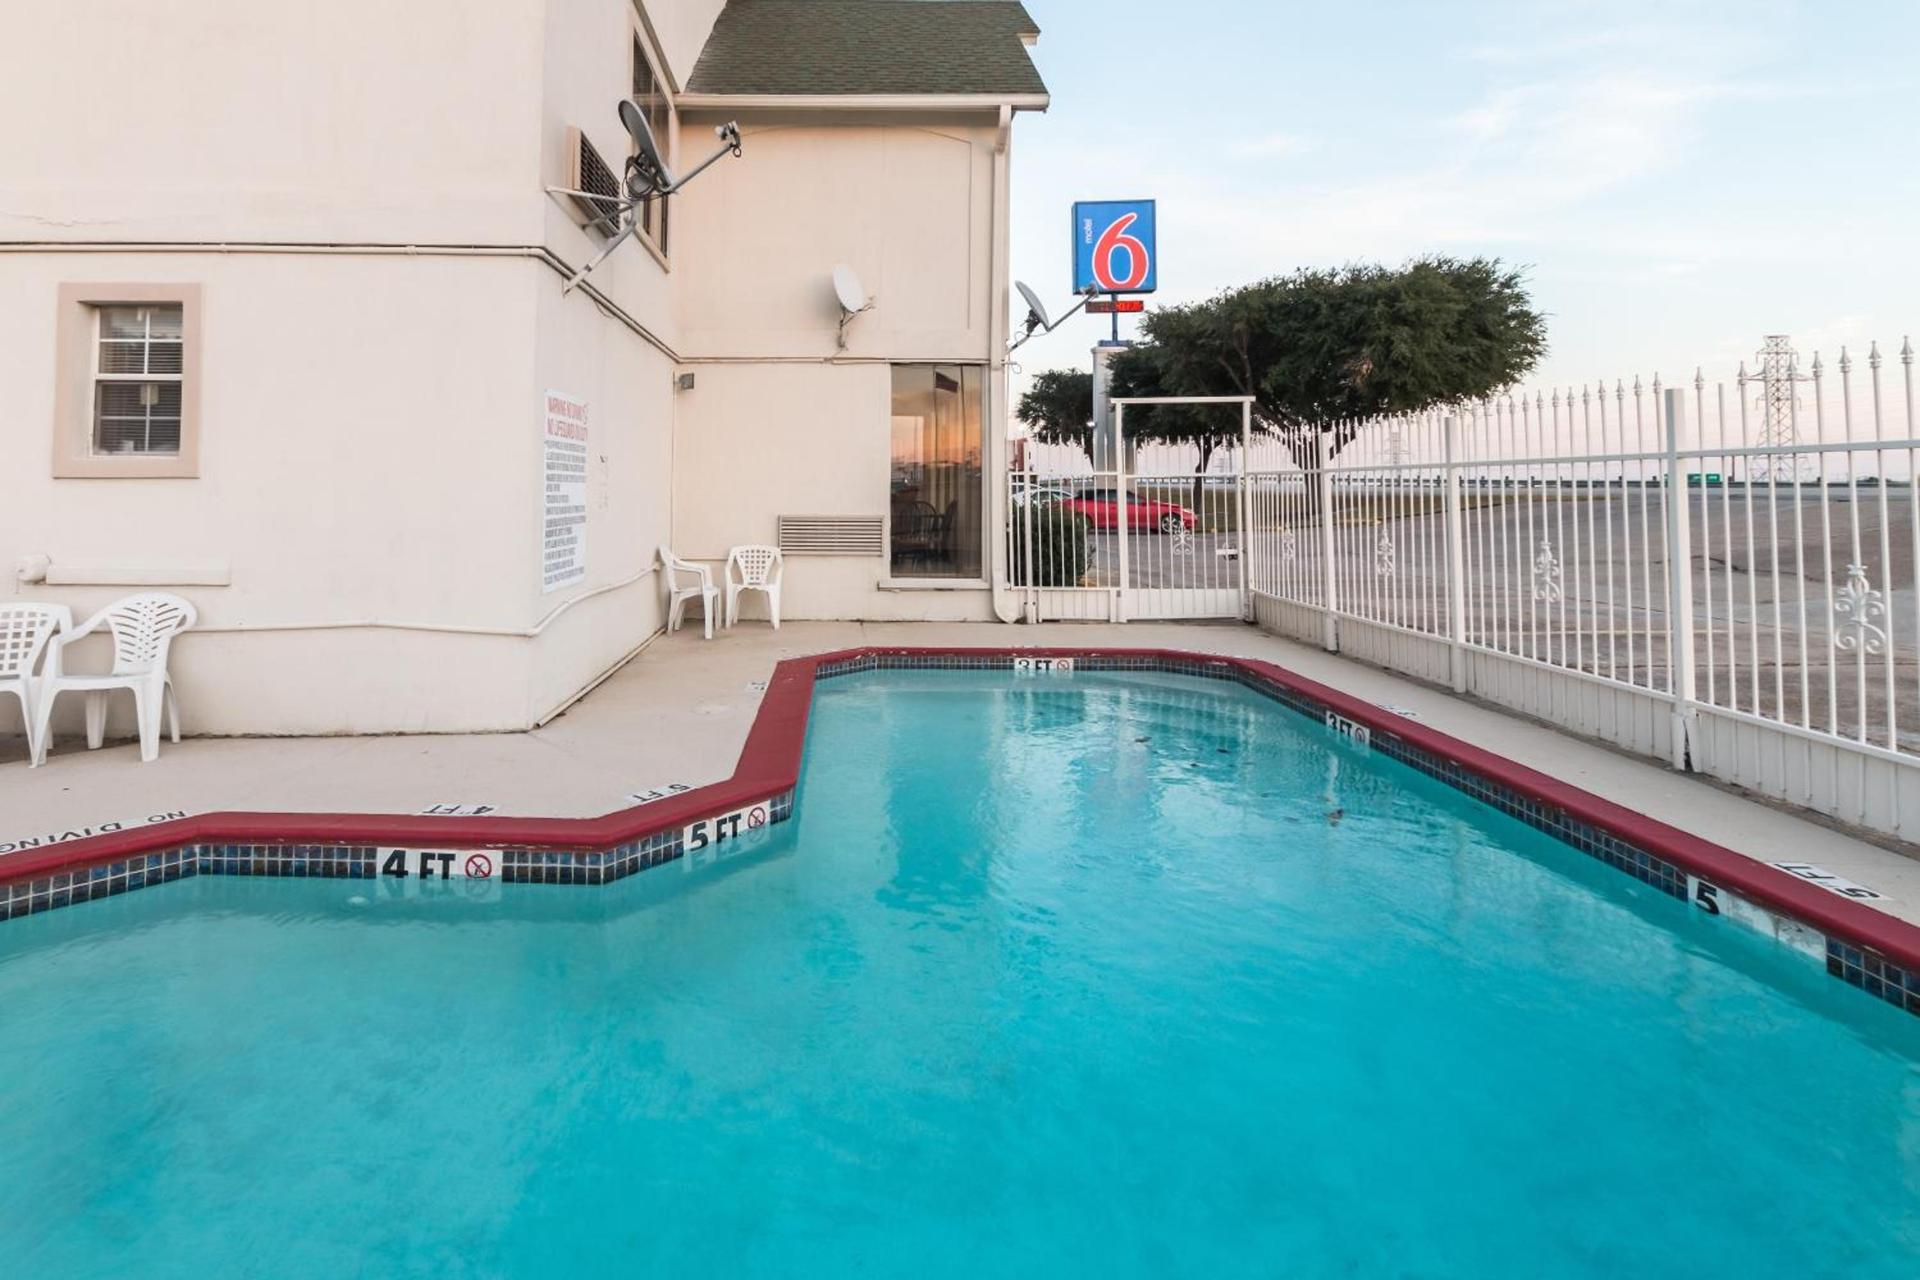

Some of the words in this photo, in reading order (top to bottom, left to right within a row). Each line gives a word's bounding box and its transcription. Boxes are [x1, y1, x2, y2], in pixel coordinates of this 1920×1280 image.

[1083, 218, 1093, 244] motel
[1092, 212, 1150, 289] 6
[147, 810, 186, 823] NO
[690, 821, 709, 852] 5
[382, 849, 409, 879] 4
[1695, 880, 1720, 915] 5
